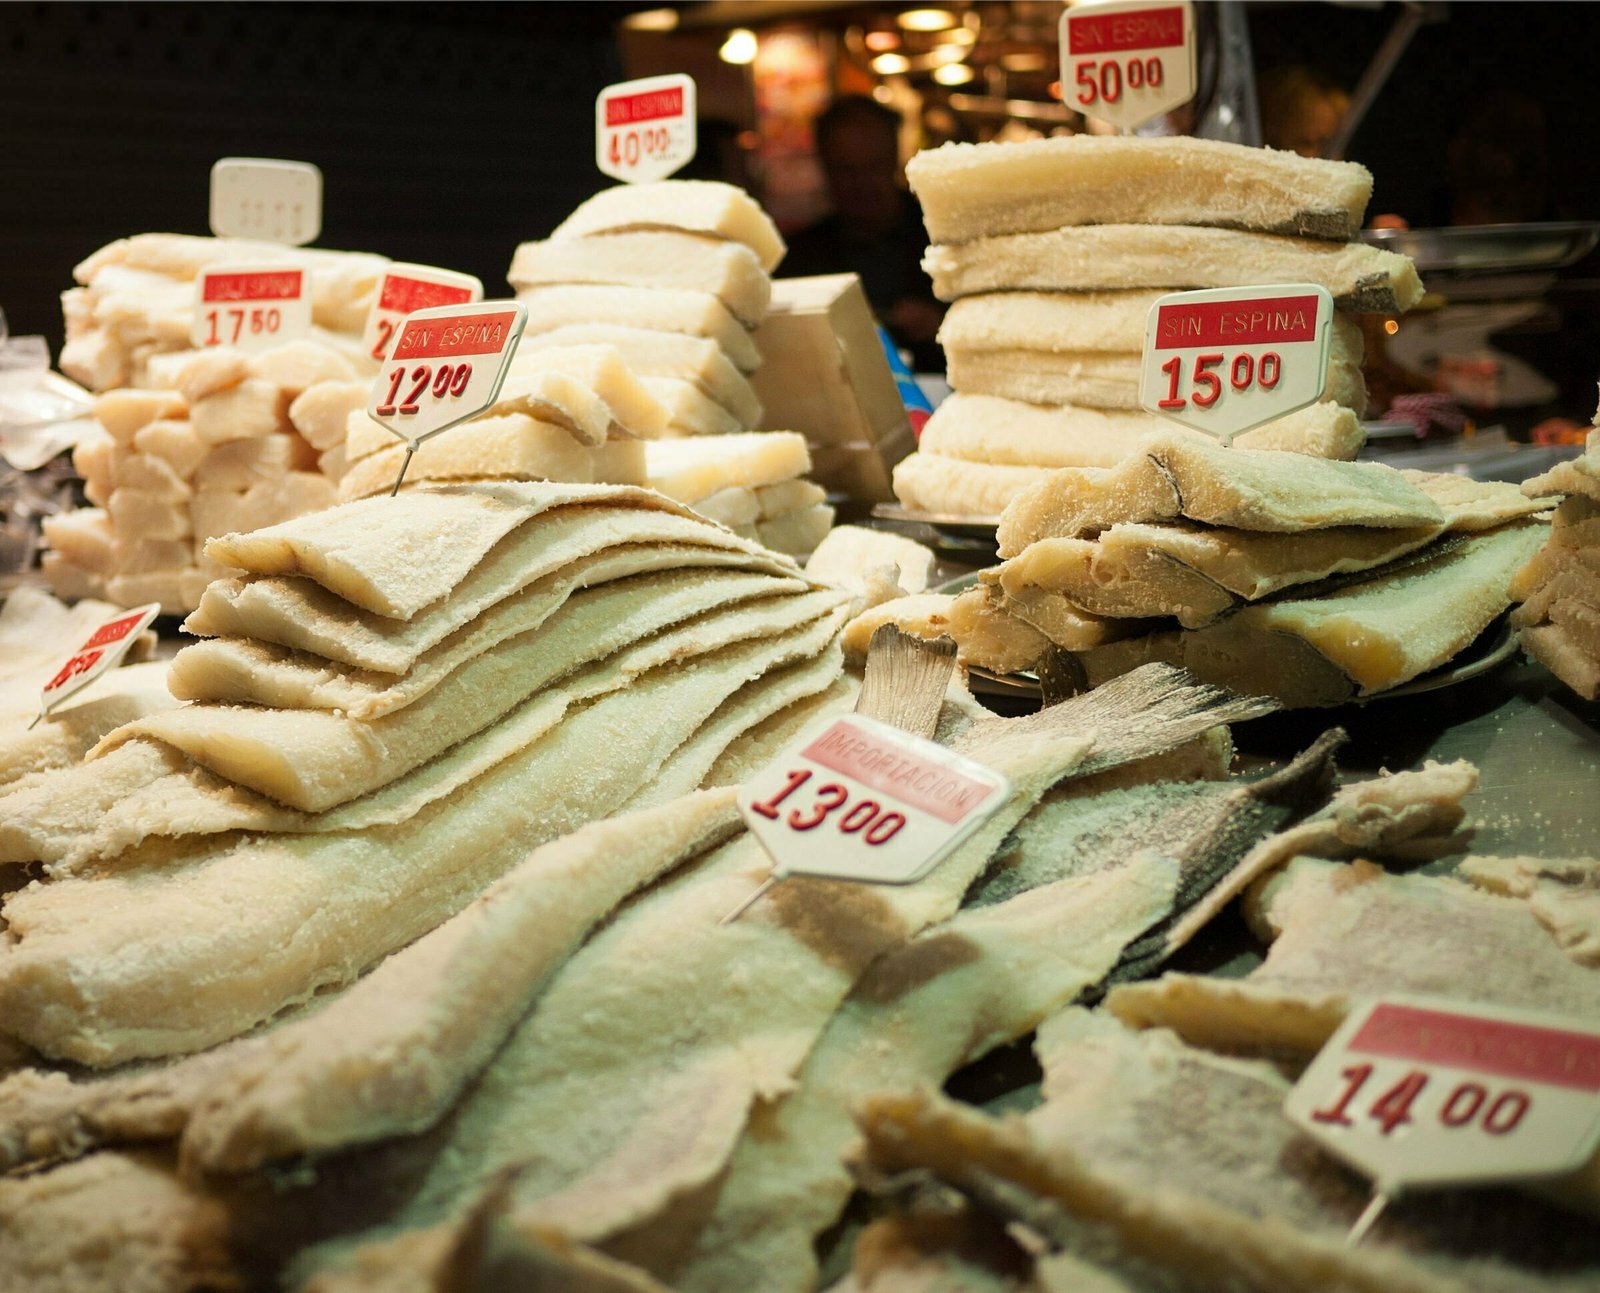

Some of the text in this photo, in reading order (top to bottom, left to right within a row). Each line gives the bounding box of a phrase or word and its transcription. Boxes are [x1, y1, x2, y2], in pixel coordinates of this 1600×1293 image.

[1074, 24, 1103, 47] SIN
[402, 322, 502, 349] SIN ESPINA
[1165, 310, 1307, 337] SIN ESPINA
[819, 731, 977, 809] IMPORTACION
